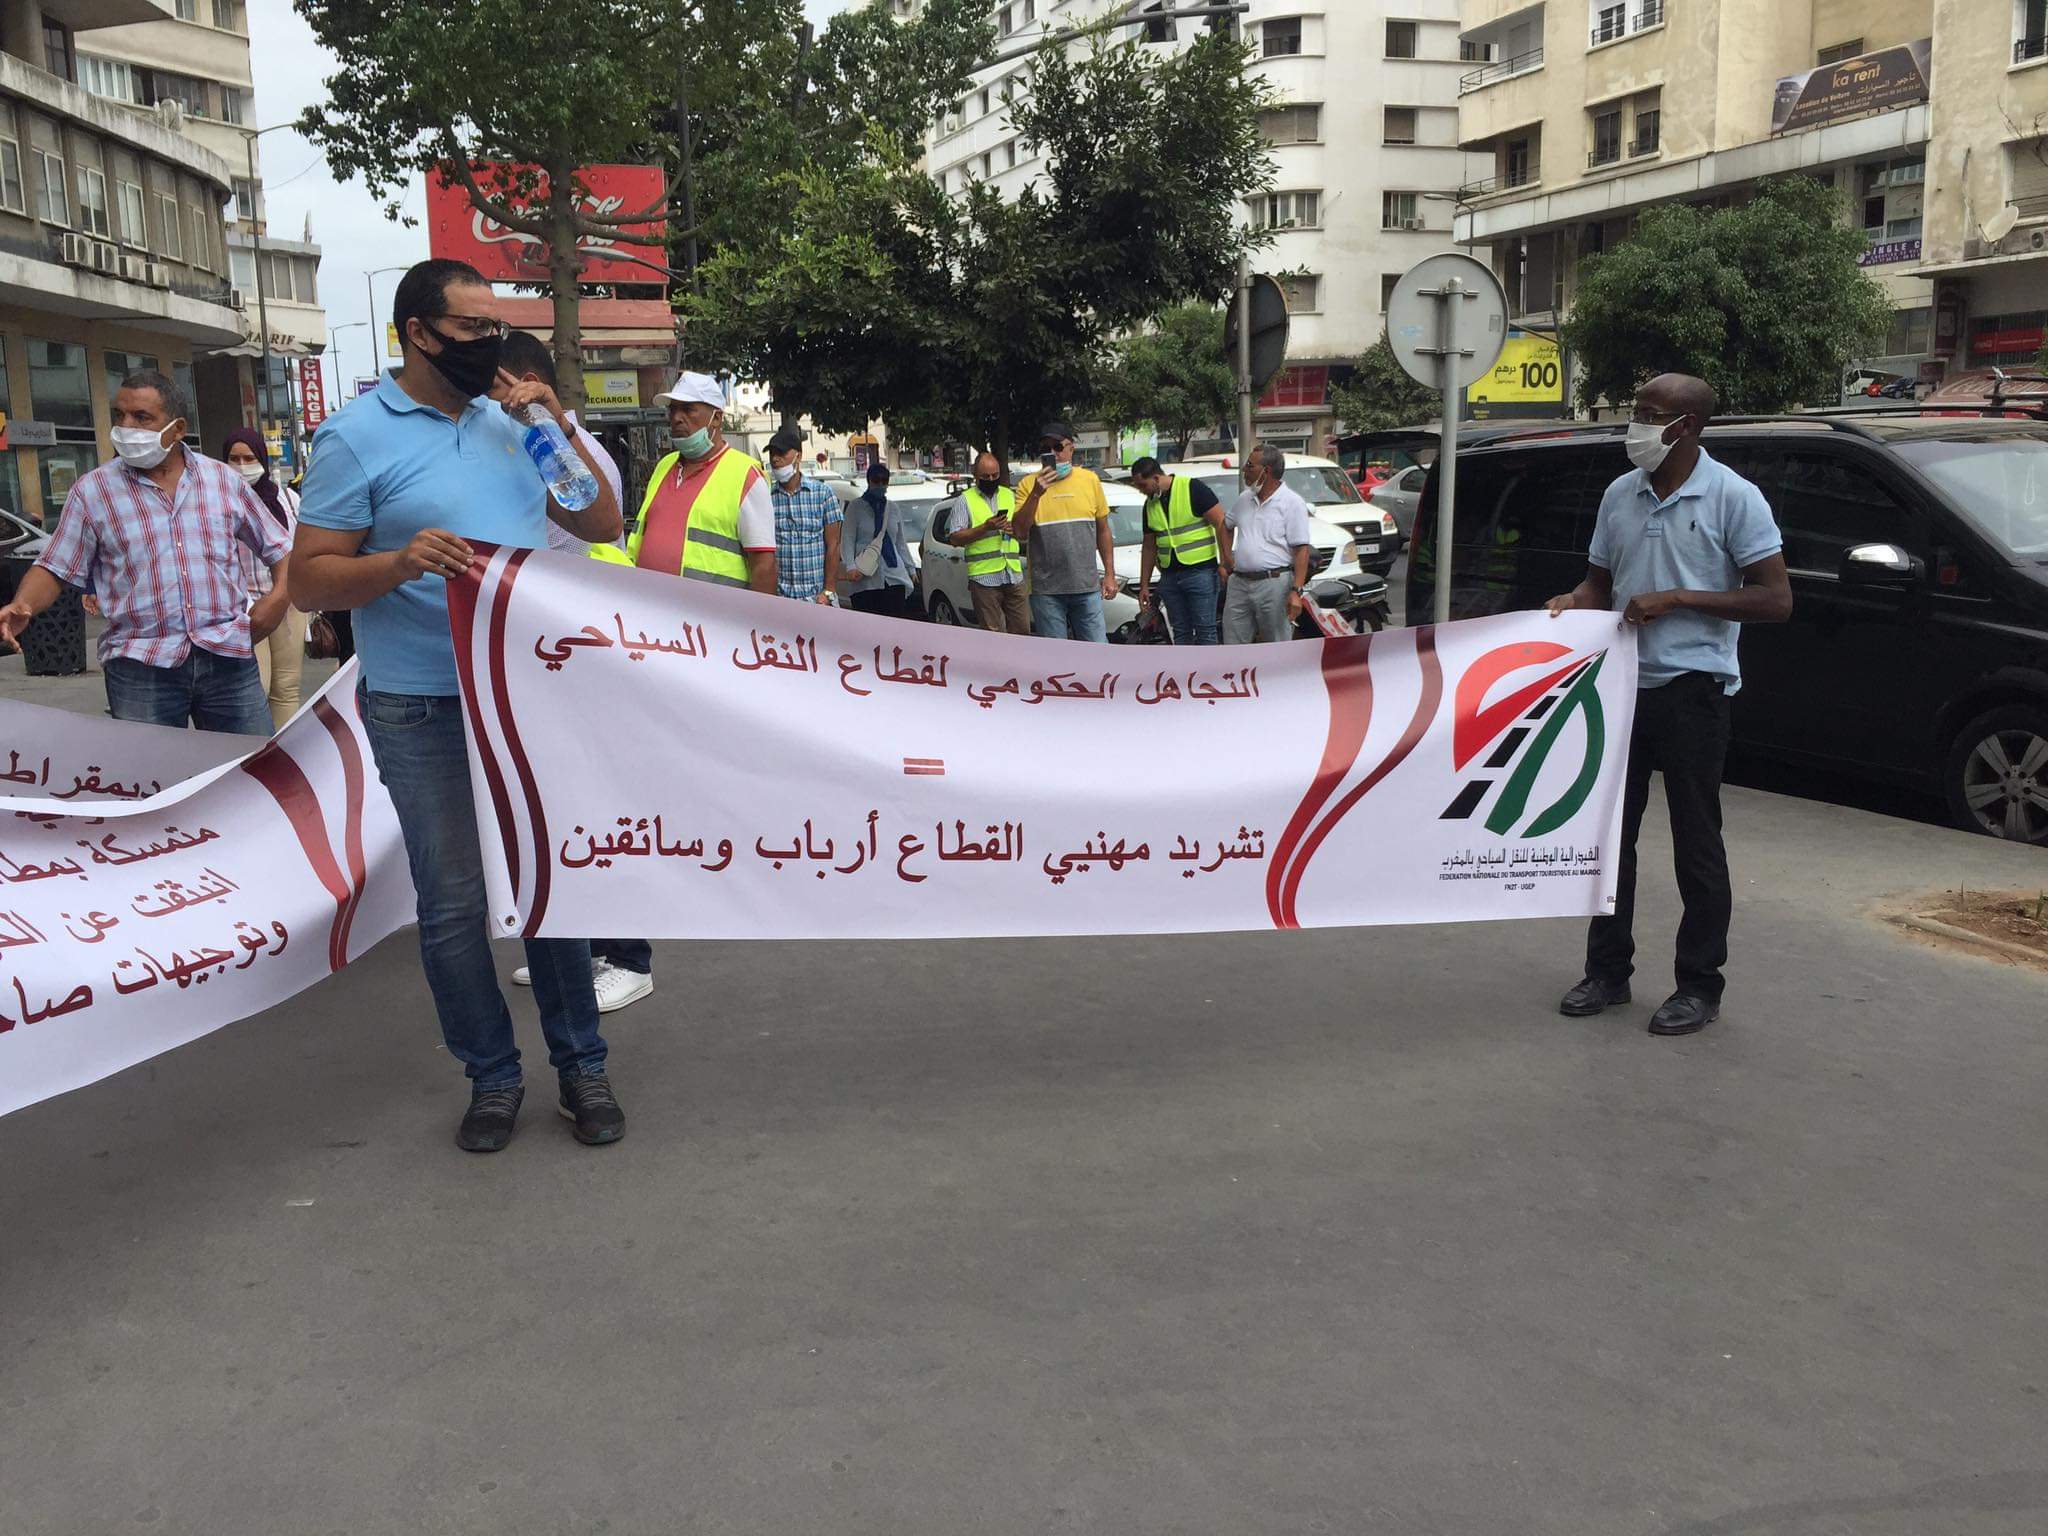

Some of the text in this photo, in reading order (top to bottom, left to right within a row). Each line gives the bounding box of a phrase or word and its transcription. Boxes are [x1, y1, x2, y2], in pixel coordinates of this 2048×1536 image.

[303, 360, 321, 422] CHANGE
[1495, 362, 1557, 388] 100 درهم
[534, 614, 1260, 710] التجاهل الحكومي لقطاع النقل السياحي
[76, 826, 221, 866] متمسكة
[560, 810, 1265, 884] تشريد مهنيي القطاع أرباب وسائقين
[1441, 845, 1599, 871] الفيدرالية الوطنية للنقل السياحي بالمغرب
[131, 867, 240, 917] انبثقت
[1439, 873, 1472, 881] FEDERATION
[1473, 872, 1500, 880] NATIONALE
[1509, 870, 1539, 879] TRANSPORT
[1539, 869, 1571, 878] TOURISTIQUE
[1579, 868, 1601, 876] MAROC
[60, 911, 120, 943] عن
[112, 920, 289, 994] وتوجيهات
